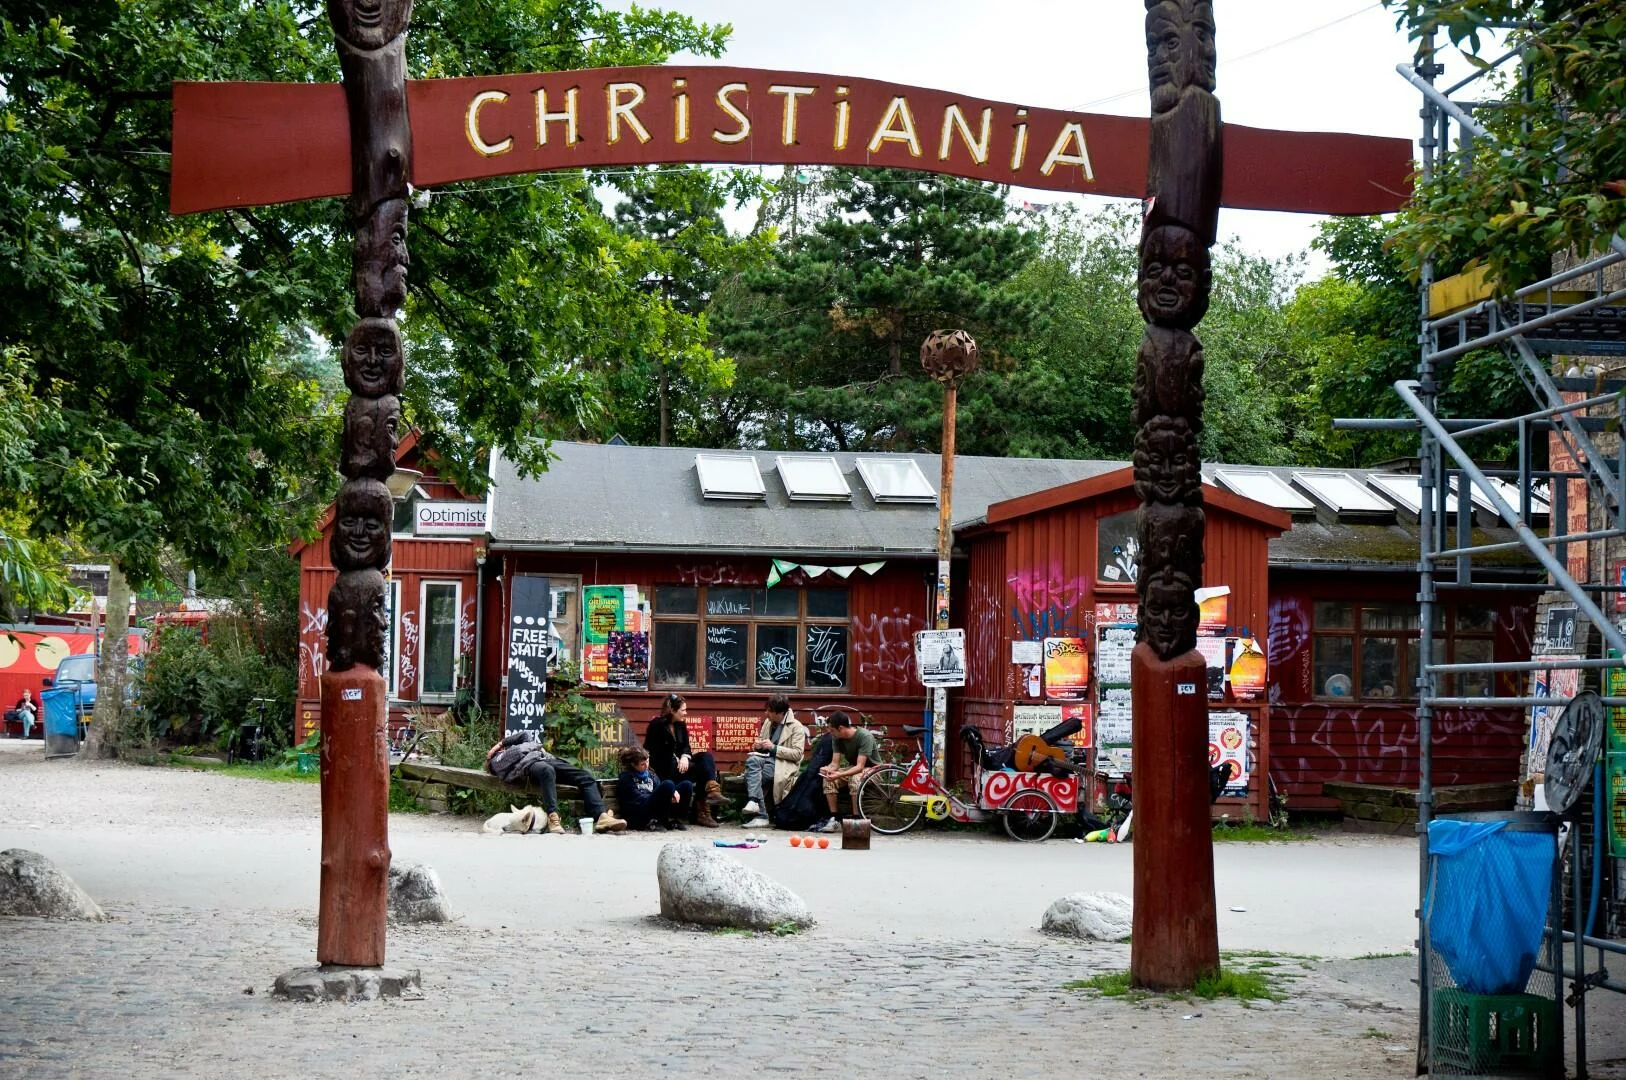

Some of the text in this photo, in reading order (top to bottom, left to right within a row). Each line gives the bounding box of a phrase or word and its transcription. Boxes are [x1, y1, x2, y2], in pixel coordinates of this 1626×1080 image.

[512, 628, 548, 643] FREE
[510, 642, 547, 658] STATE
[508, 657, 547, 693] MUSEUM
[511, 688, 537, 703] ART
[509, 702, 546, 717] SHOW
[718, 722, 754, 730] VISNINGER
[750, 727, 759, 736] PÅ
